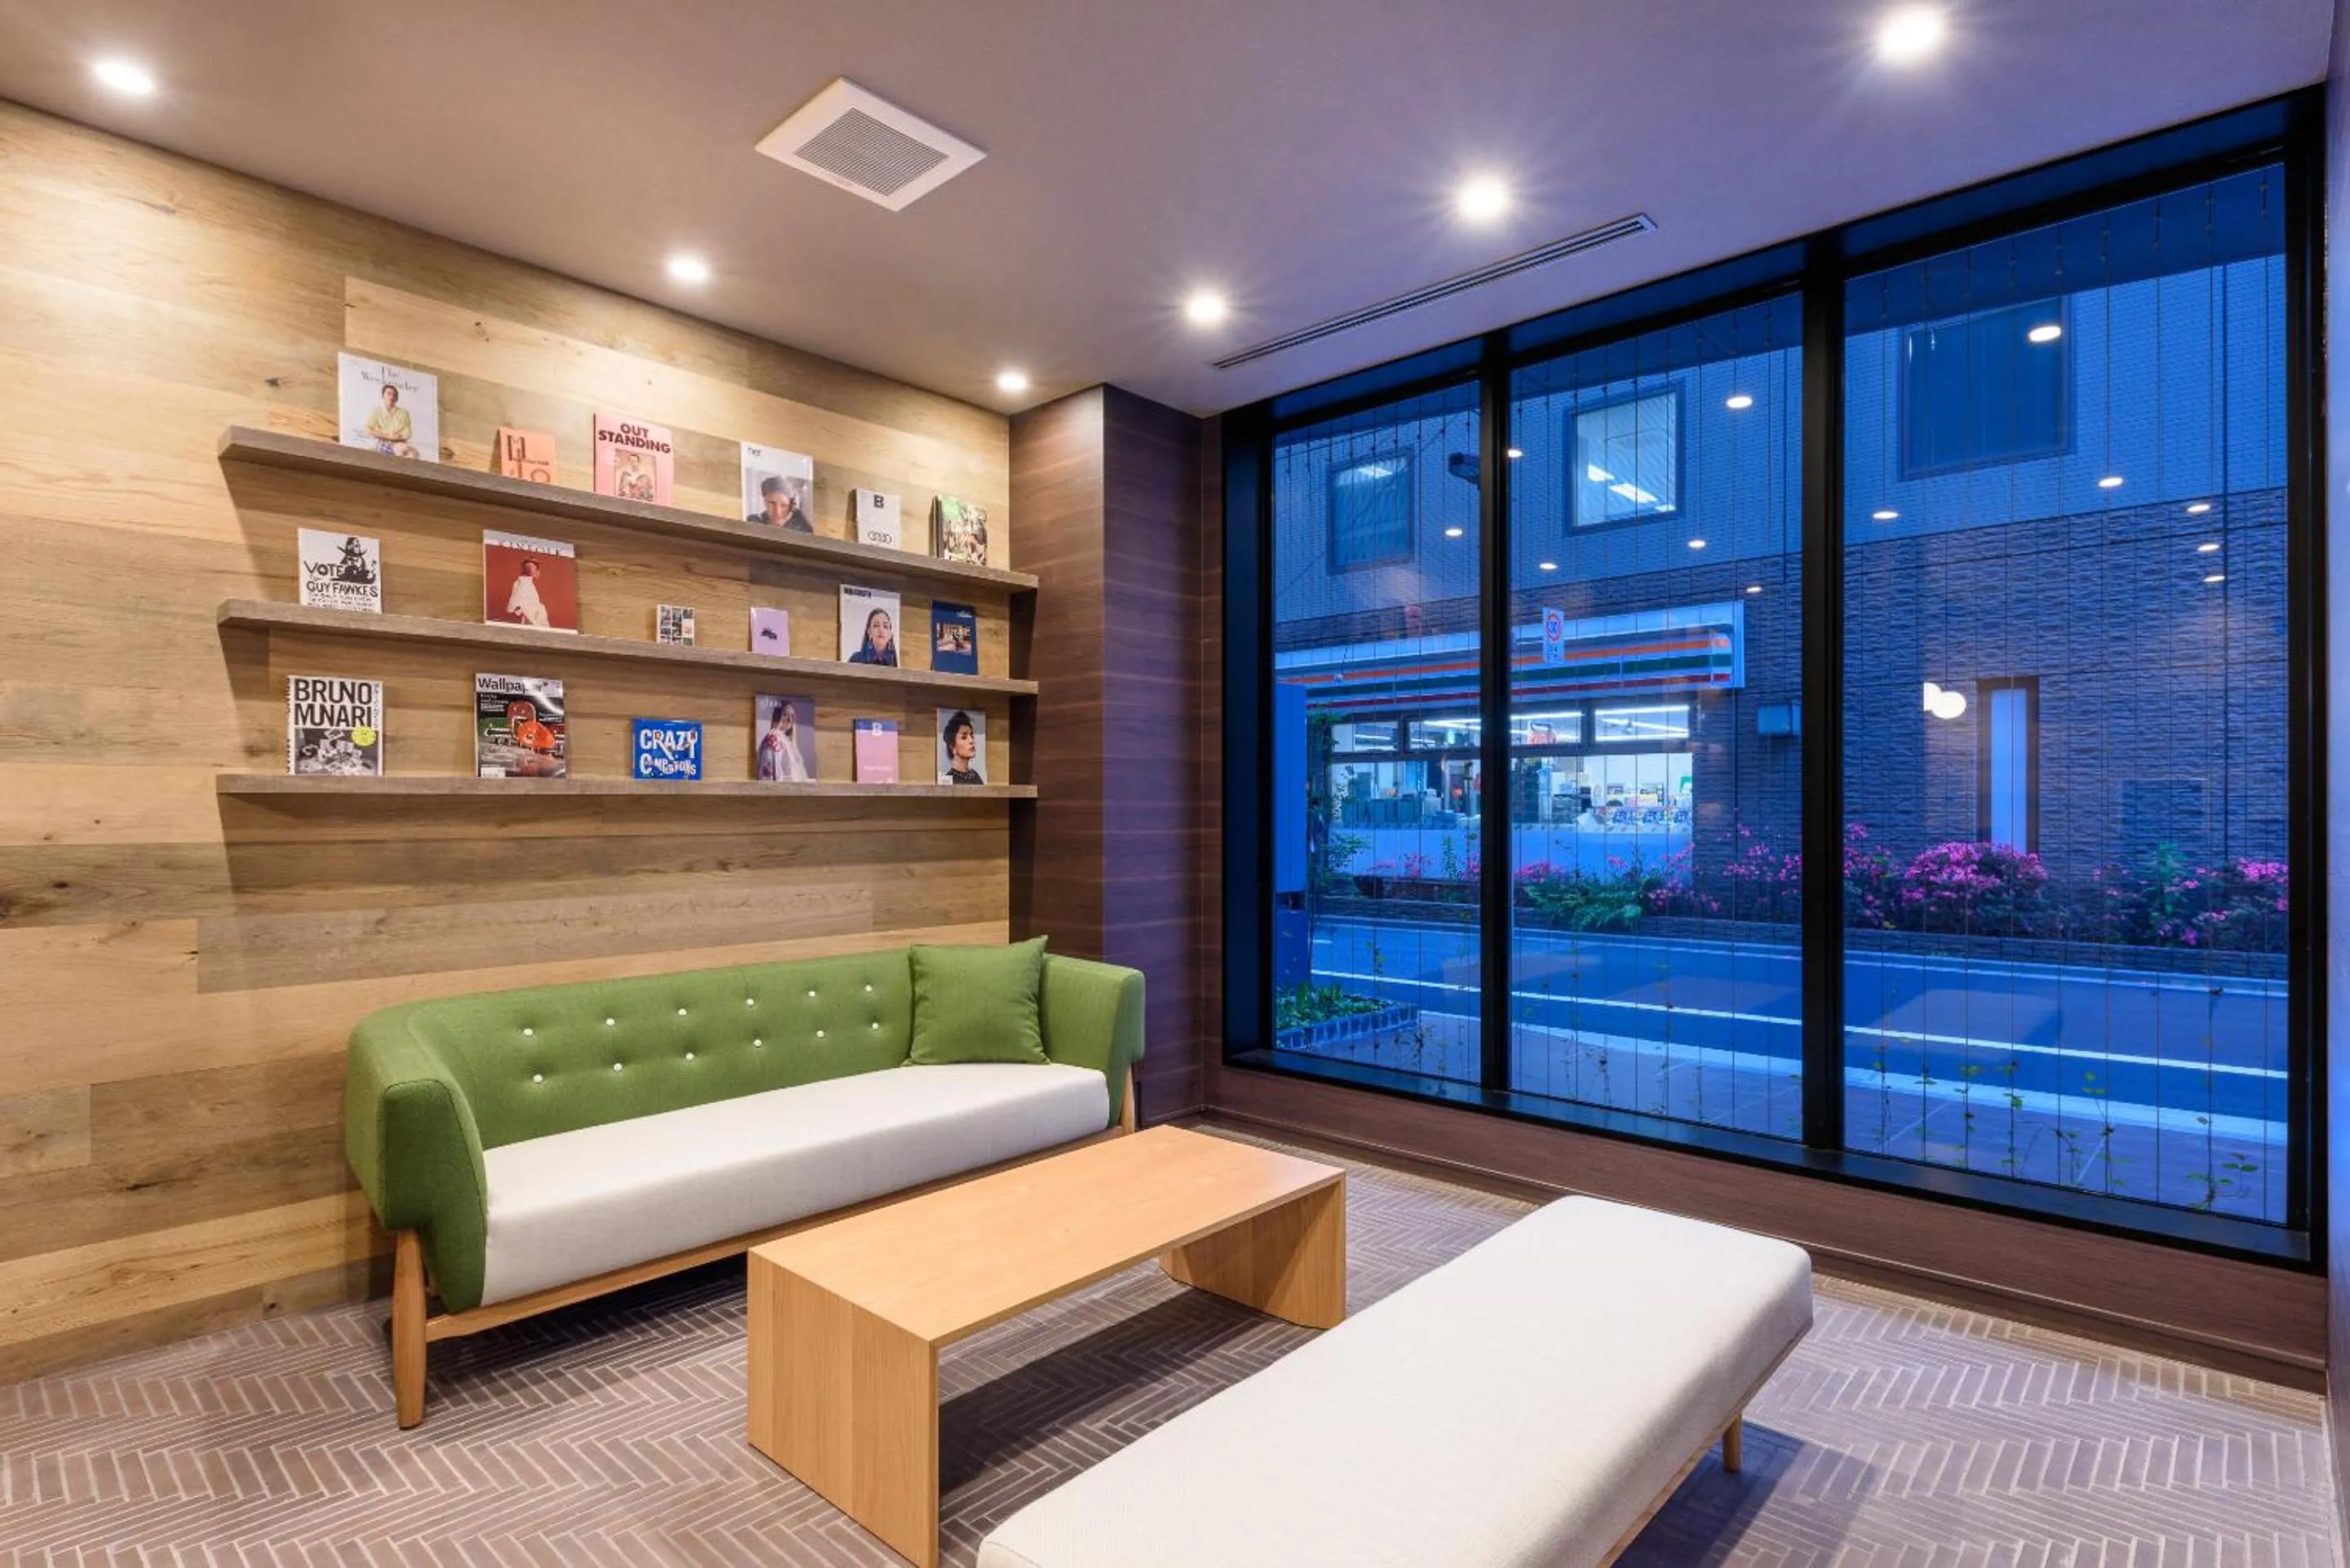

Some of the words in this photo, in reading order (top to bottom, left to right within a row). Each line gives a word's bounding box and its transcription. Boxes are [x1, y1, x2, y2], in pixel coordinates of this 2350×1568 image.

[620, 423, 649, 437] OUT
[598, 429, 671, 454] STANDING
[874, 494, 885, 508] B
[304, 560, 344, 578] VOTE
[307, 581, 330, 593] GUY
[332, 582, 379, 597] FAWKES
[294, 678, 372, 705] BRUNO
[478, 677, 543, 693] Wallpar
[295, 702, 372, 728] MUNARI
[872, 721, 883, 736] B
[640, 728, 698, 760] CRAZY
